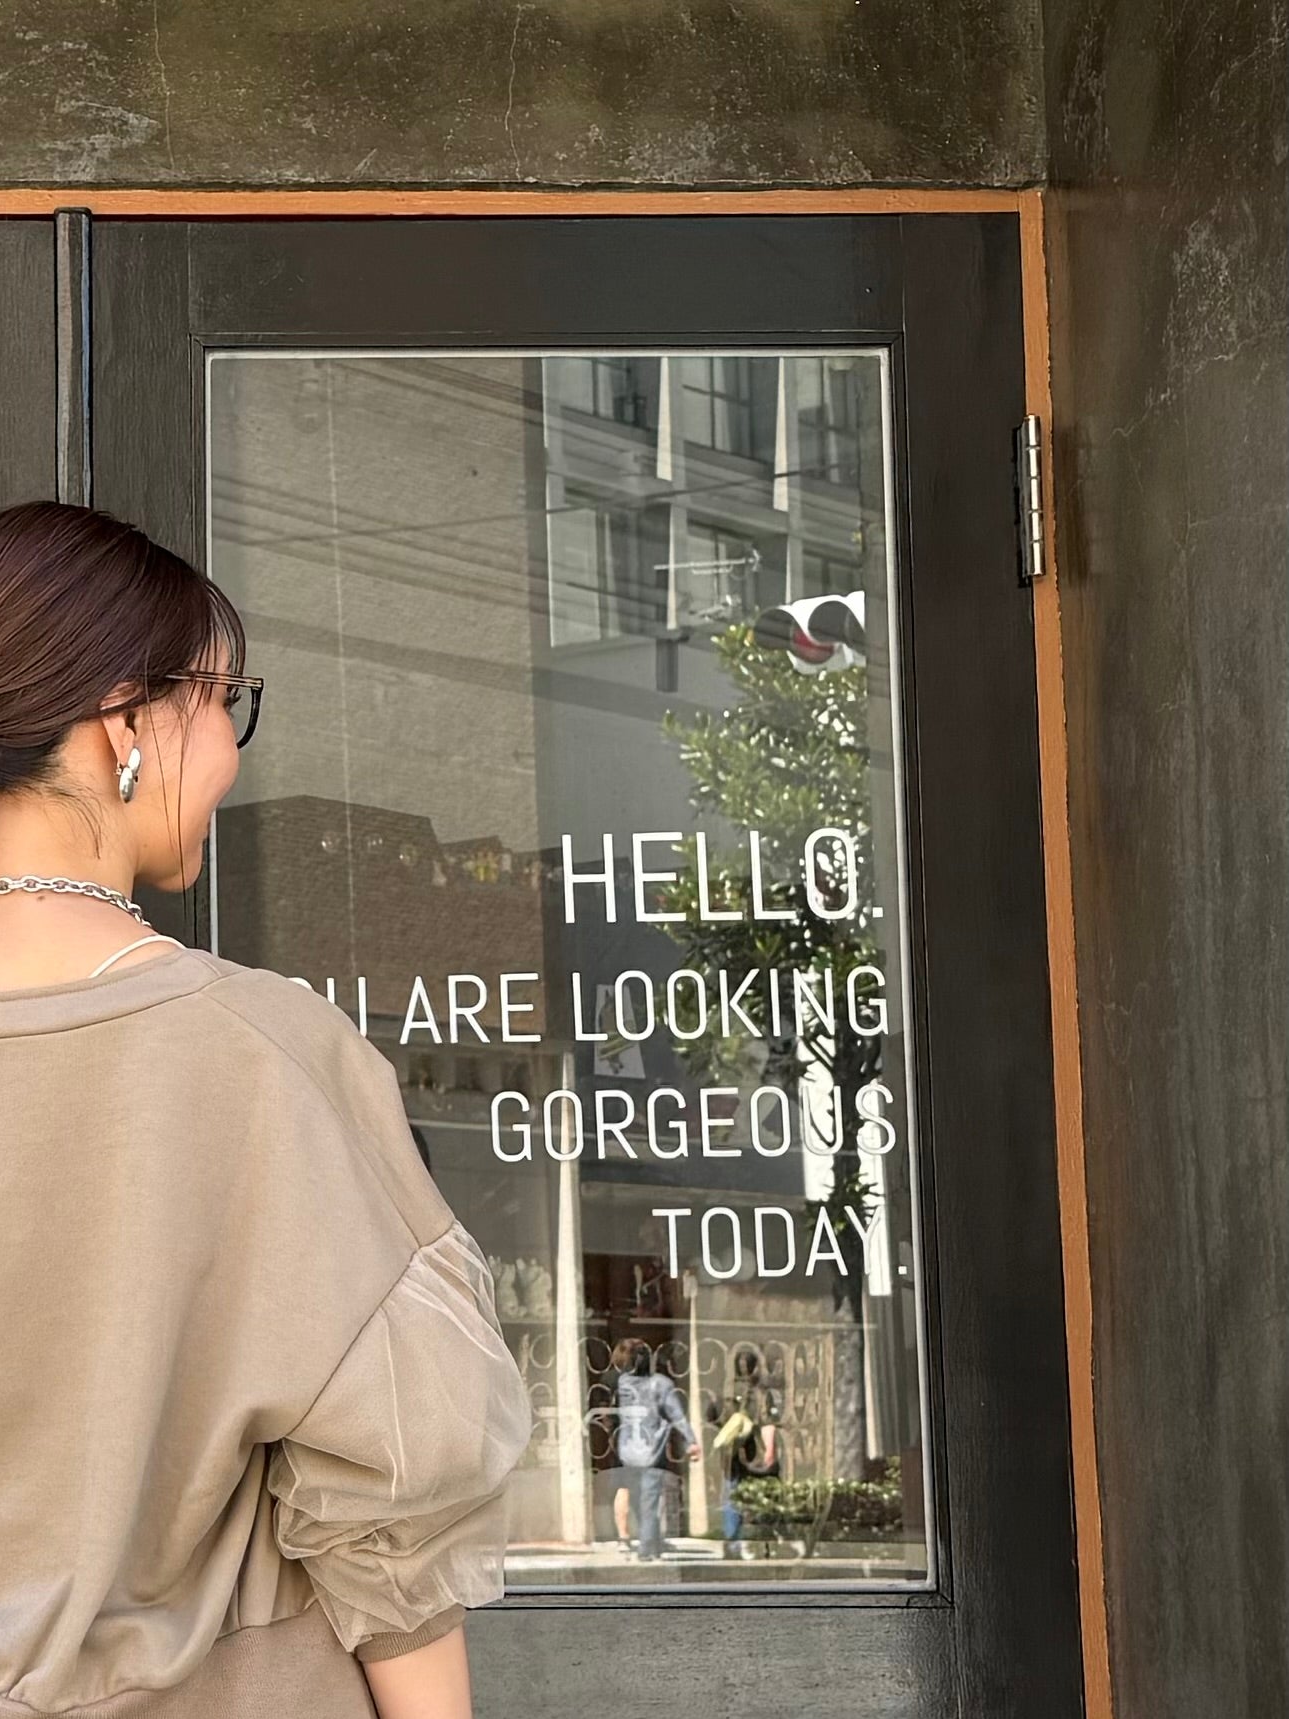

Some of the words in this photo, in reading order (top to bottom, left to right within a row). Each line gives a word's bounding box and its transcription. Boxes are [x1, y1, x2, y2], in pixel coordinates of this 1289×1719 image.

[561, 827, 884, 924] HELLO.
[399, 973, 542, 1045] ARE
[572, 966, 890, 1041] LOOKING
[490, 1084, 896, 1162] GORGEOUS
[652, 1206, 908, 1278] TODAY.
